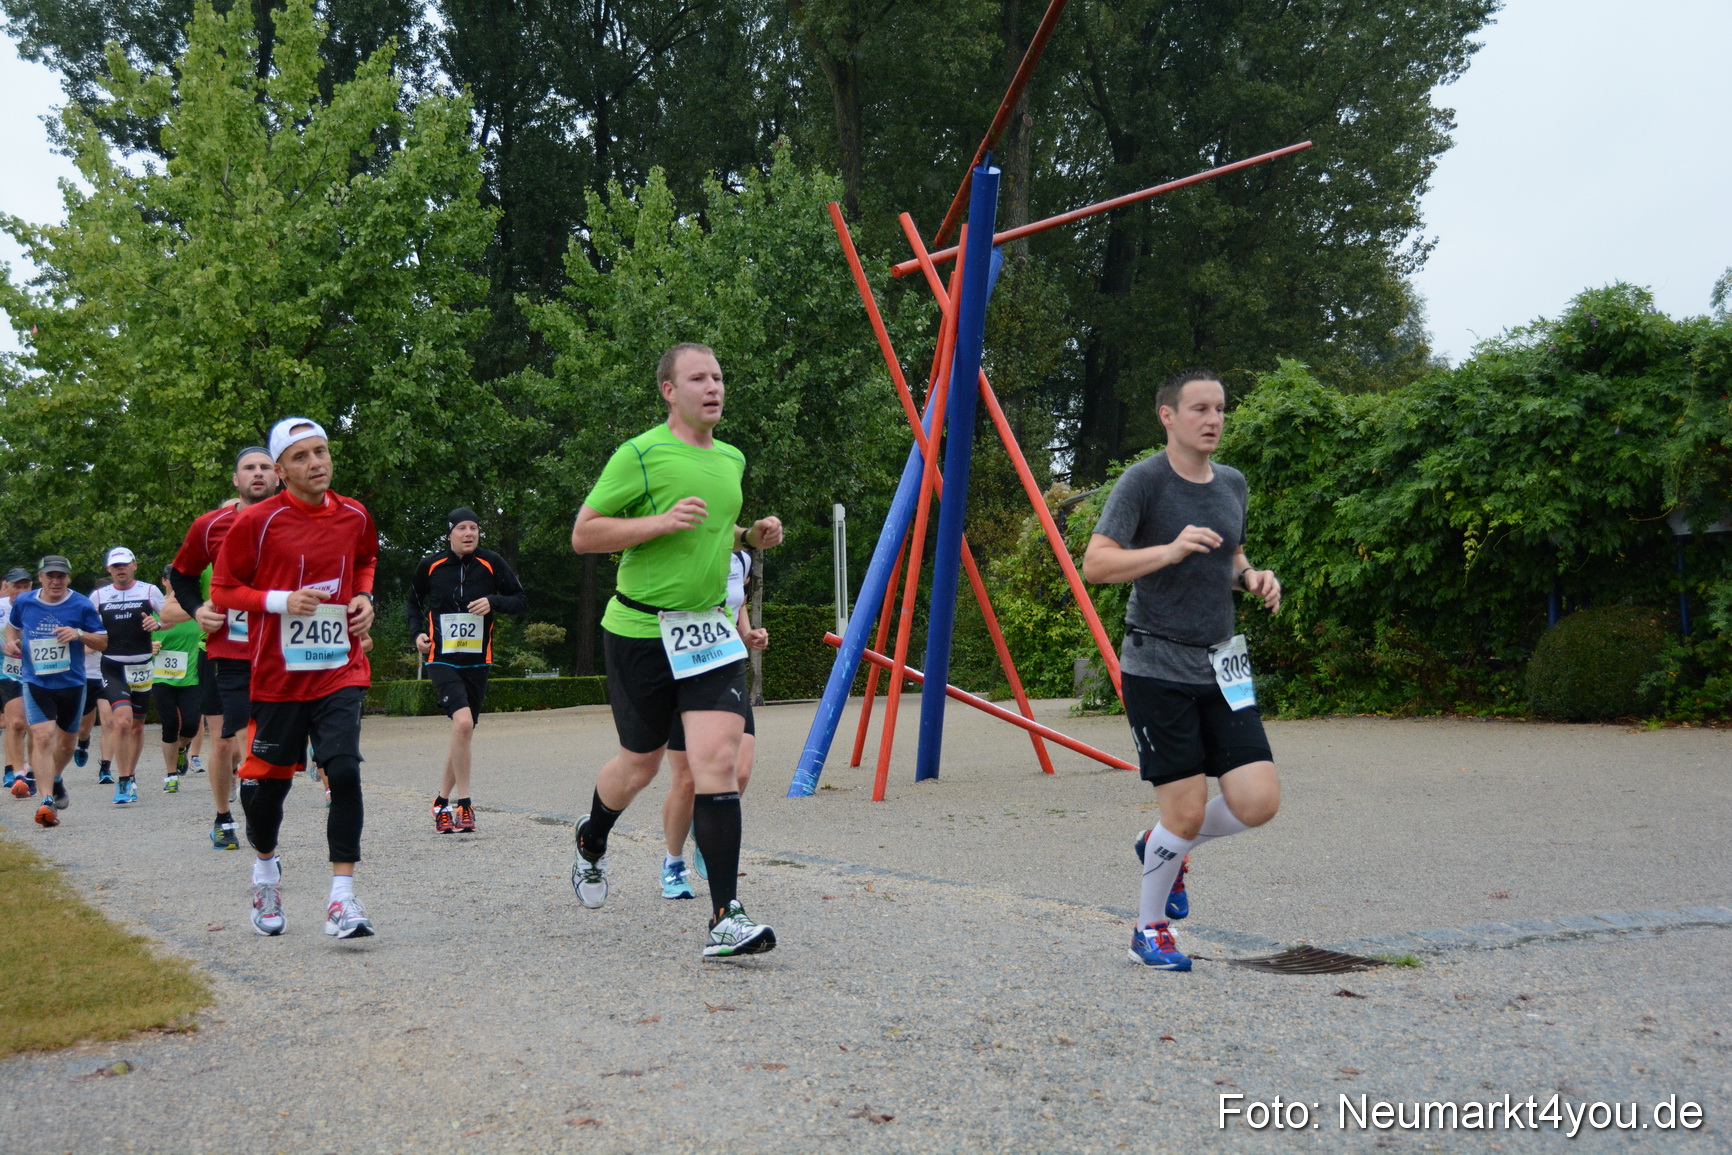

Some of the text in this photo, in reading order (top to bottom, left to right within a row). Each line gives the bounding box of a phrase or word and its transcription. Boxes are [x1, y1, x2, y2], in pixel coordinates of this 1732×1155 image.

[104, 601, 144, 611] Energizer
[289, 620, 345, 645] 2462
[450, 622, 476, 638] 262
[671, 621, 731, 651] 2384
[33, 646, 66, 661] 2257
[305, 650, 334, 661] Daniel
[692, 649, 723, 665] Martin
[164, 657, 178, 669] 33
[131, 669, 151, 683] 237
